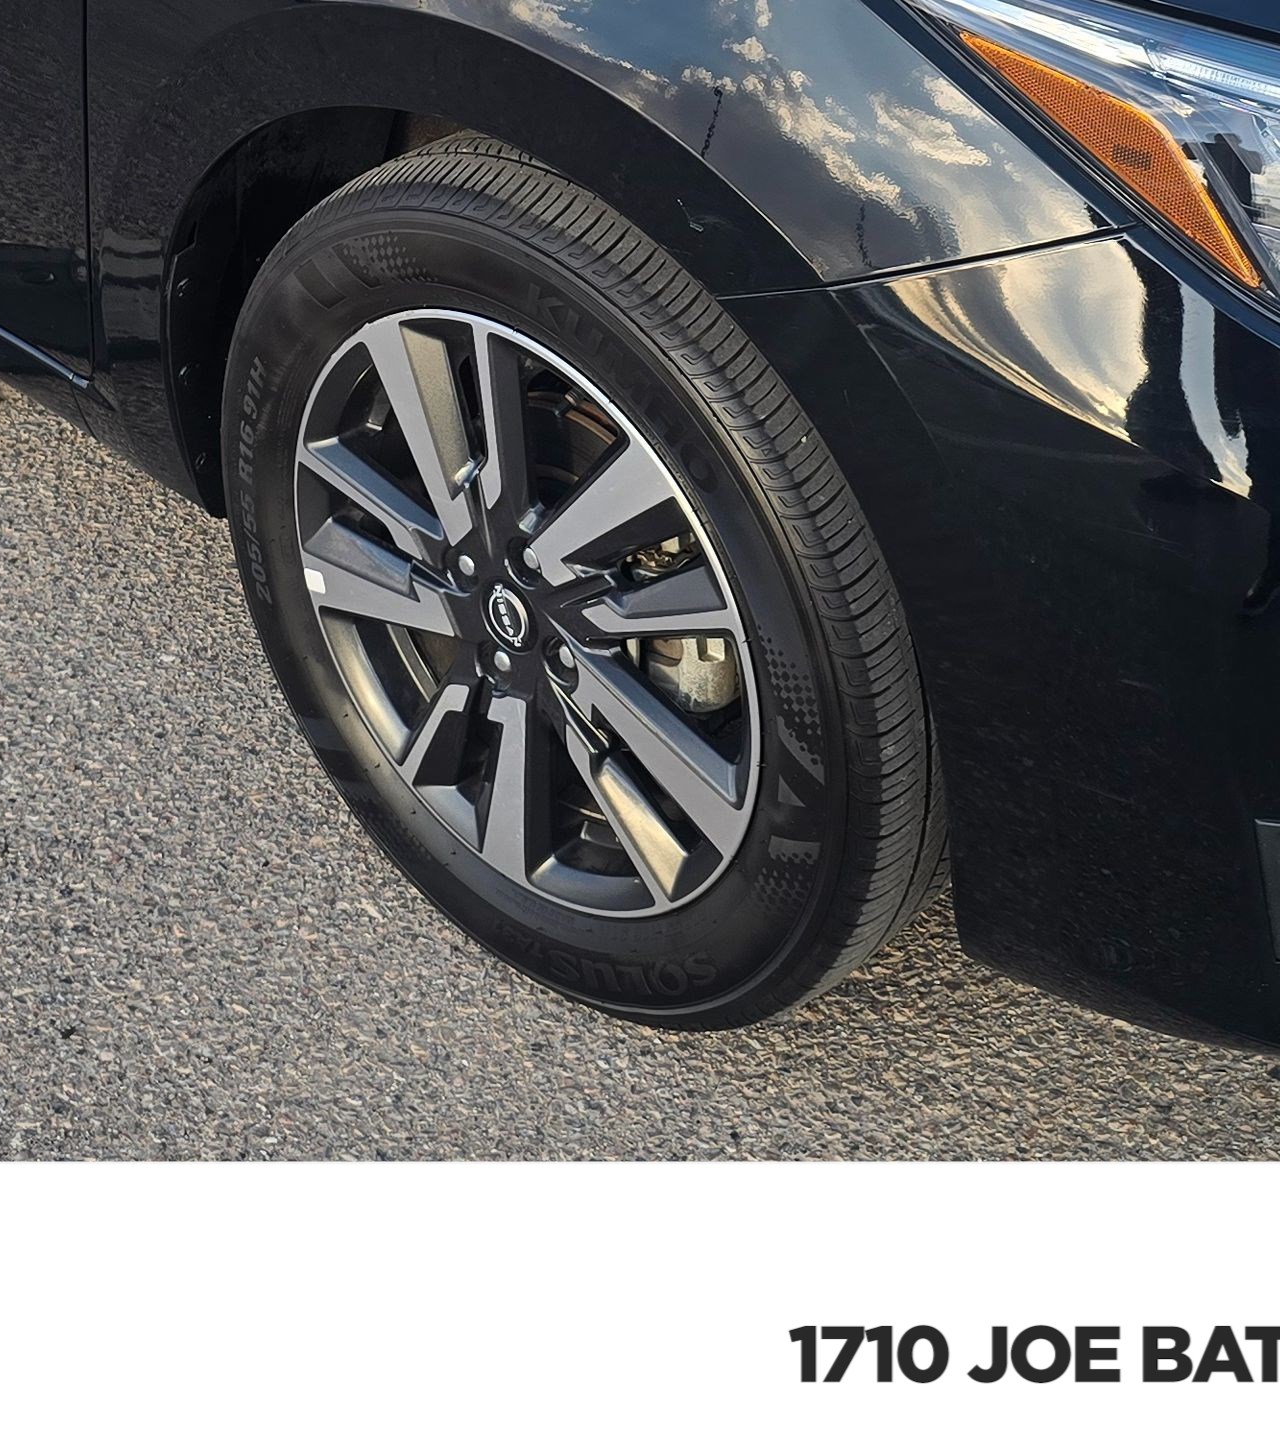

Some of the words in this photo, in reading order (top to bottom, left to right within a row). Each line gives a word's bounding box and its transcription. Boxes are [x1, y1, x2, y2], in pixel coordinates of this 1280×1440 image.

[241, 355, 267, 421] 91H
[237, 419, 257, 486] R16
[238, 488, 273, 605] 205/55
[546, 948, 718, 996] SOLUS
